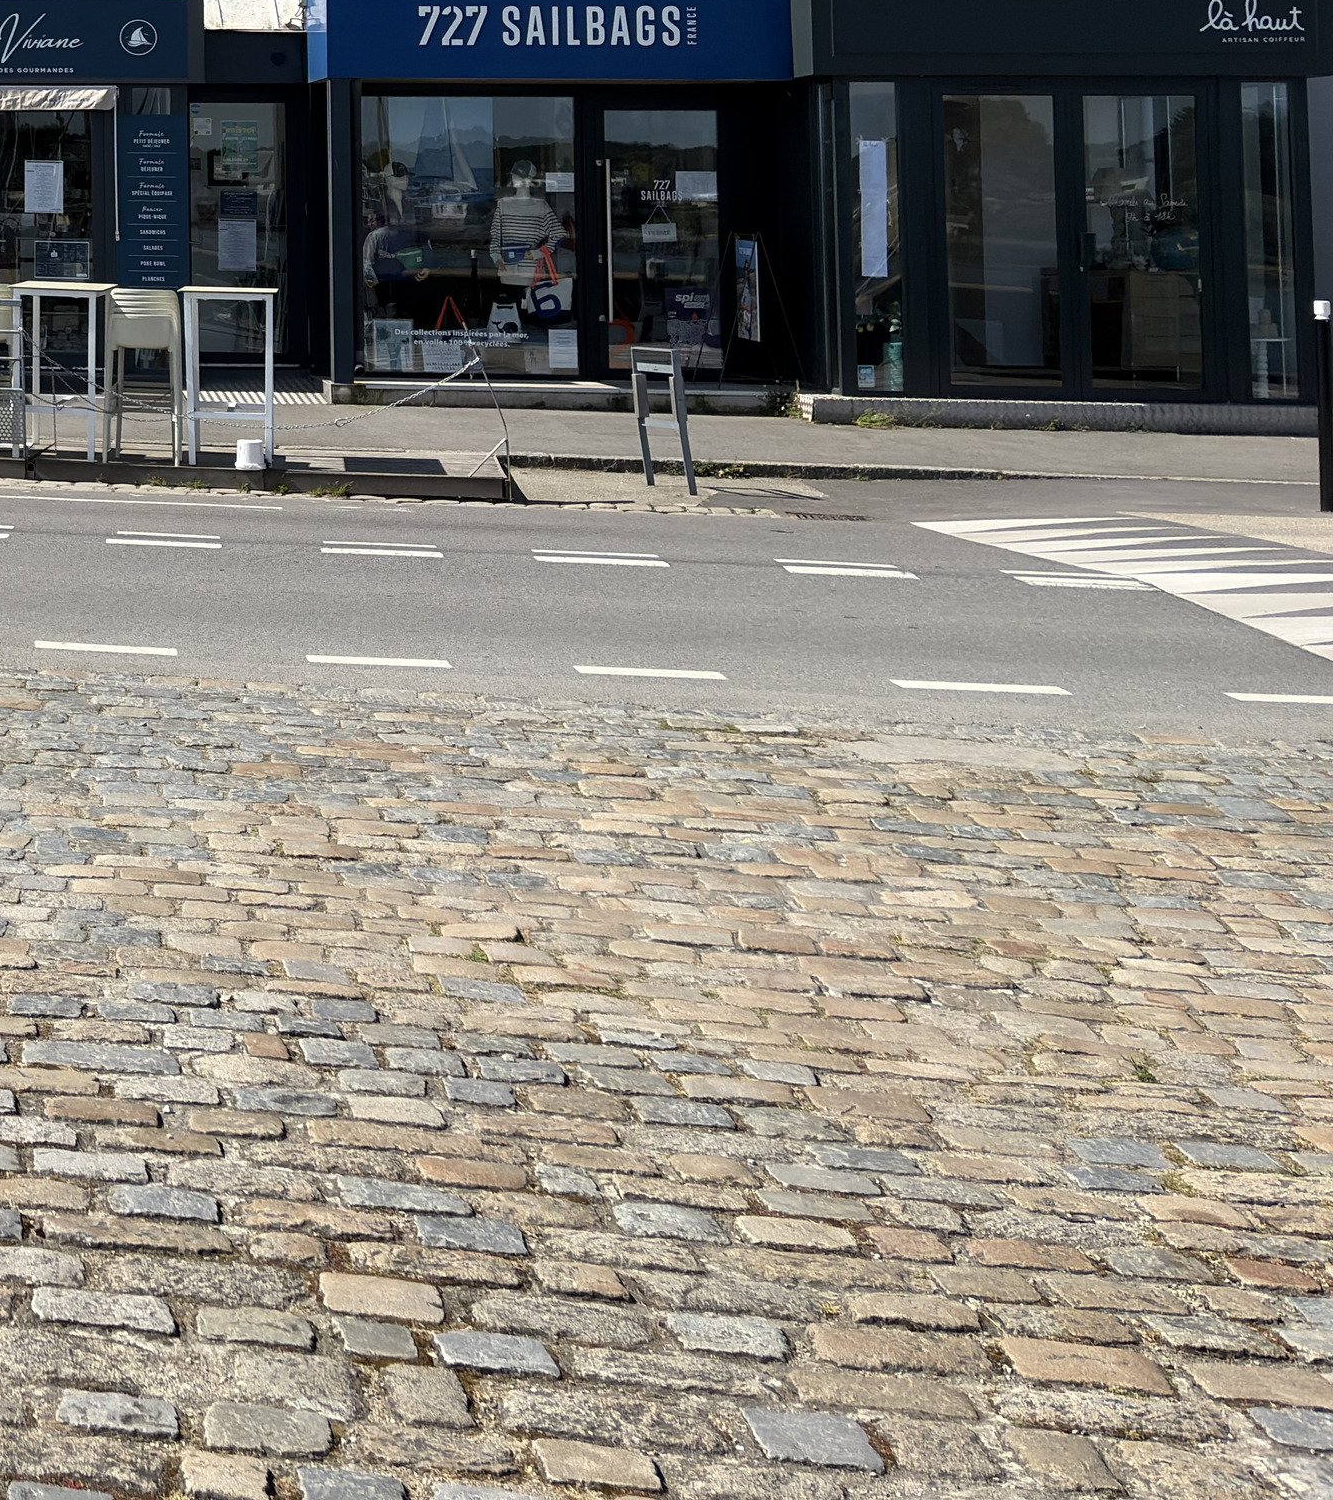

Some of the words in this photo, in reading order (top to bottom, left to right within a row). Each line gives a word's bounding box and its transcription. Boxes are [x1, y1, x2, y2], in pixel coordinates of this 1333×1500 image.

[418, 5, 488, 46] 727
[501, 5, 681, 47] SAILBAGS
[686, 6, 698, 45] FRANCE
[653, 179, 671, 190] 727
[640, 190, 683, 201] SAILBAGS
[675, 292, 695, 304] spi
[395, 328, 409, 336] Des
[410, 328, 451, 336] collections
